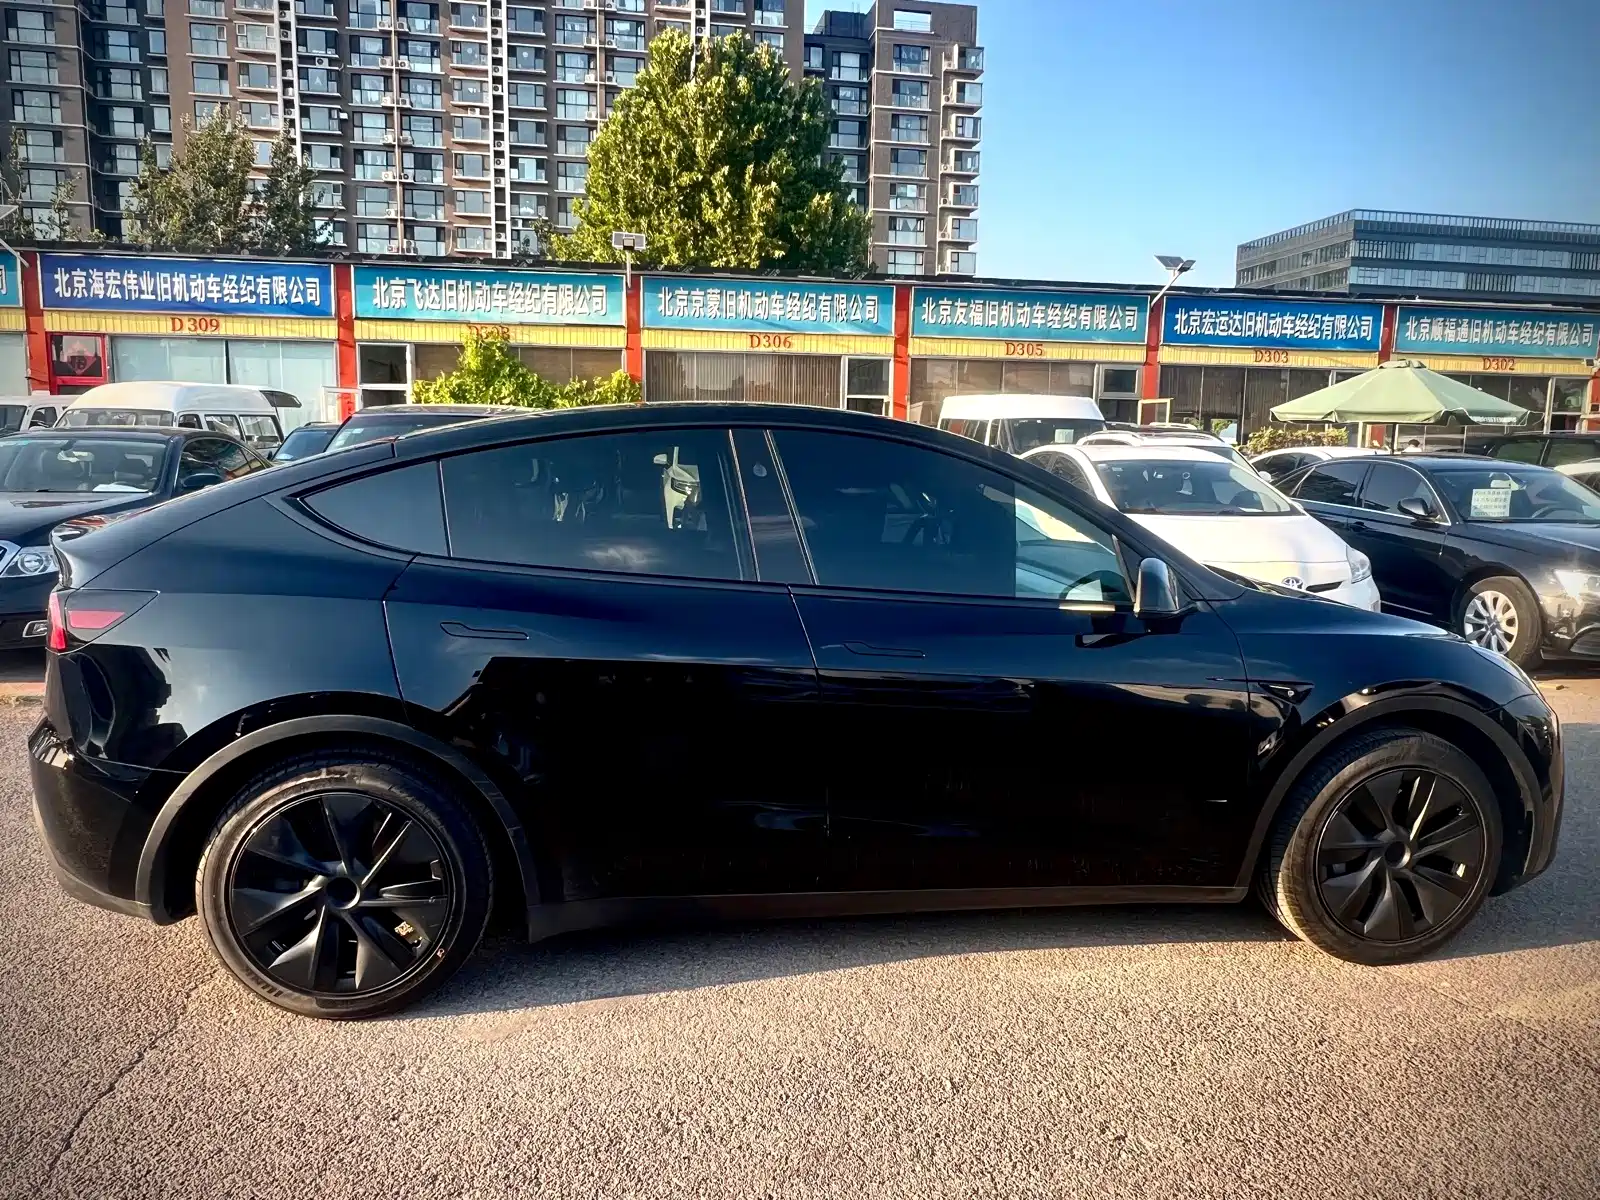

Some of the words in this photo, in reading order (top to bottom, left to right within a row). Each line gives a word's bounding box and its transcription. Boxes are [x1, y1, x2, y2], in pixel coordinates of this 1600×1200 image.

[54, 267, 321, 306] 北京海宏伟业旧机动车经纪有限公司
[372, 276, 608, 317] 北京飞达旧机动车经纪有限公司
[657, 286, 879, 323] 北京京蒙旧机动车经纪有限公司
[922, 297, 1138, 331] 北京友福旧机动车经纪有限公司
[1174, 308, 1373, 341] 北京宏运达旧机动车经纪有限公司
[1406, 316, 1593, 347] 北京顺福通旧机动车经纪有限公司
[749, 334, 792, 349] D306
[1004, 342, 1044, 356] D305
[1254, 350, 1289, 363] D303
[1482, 358, 1515, 371] D302
